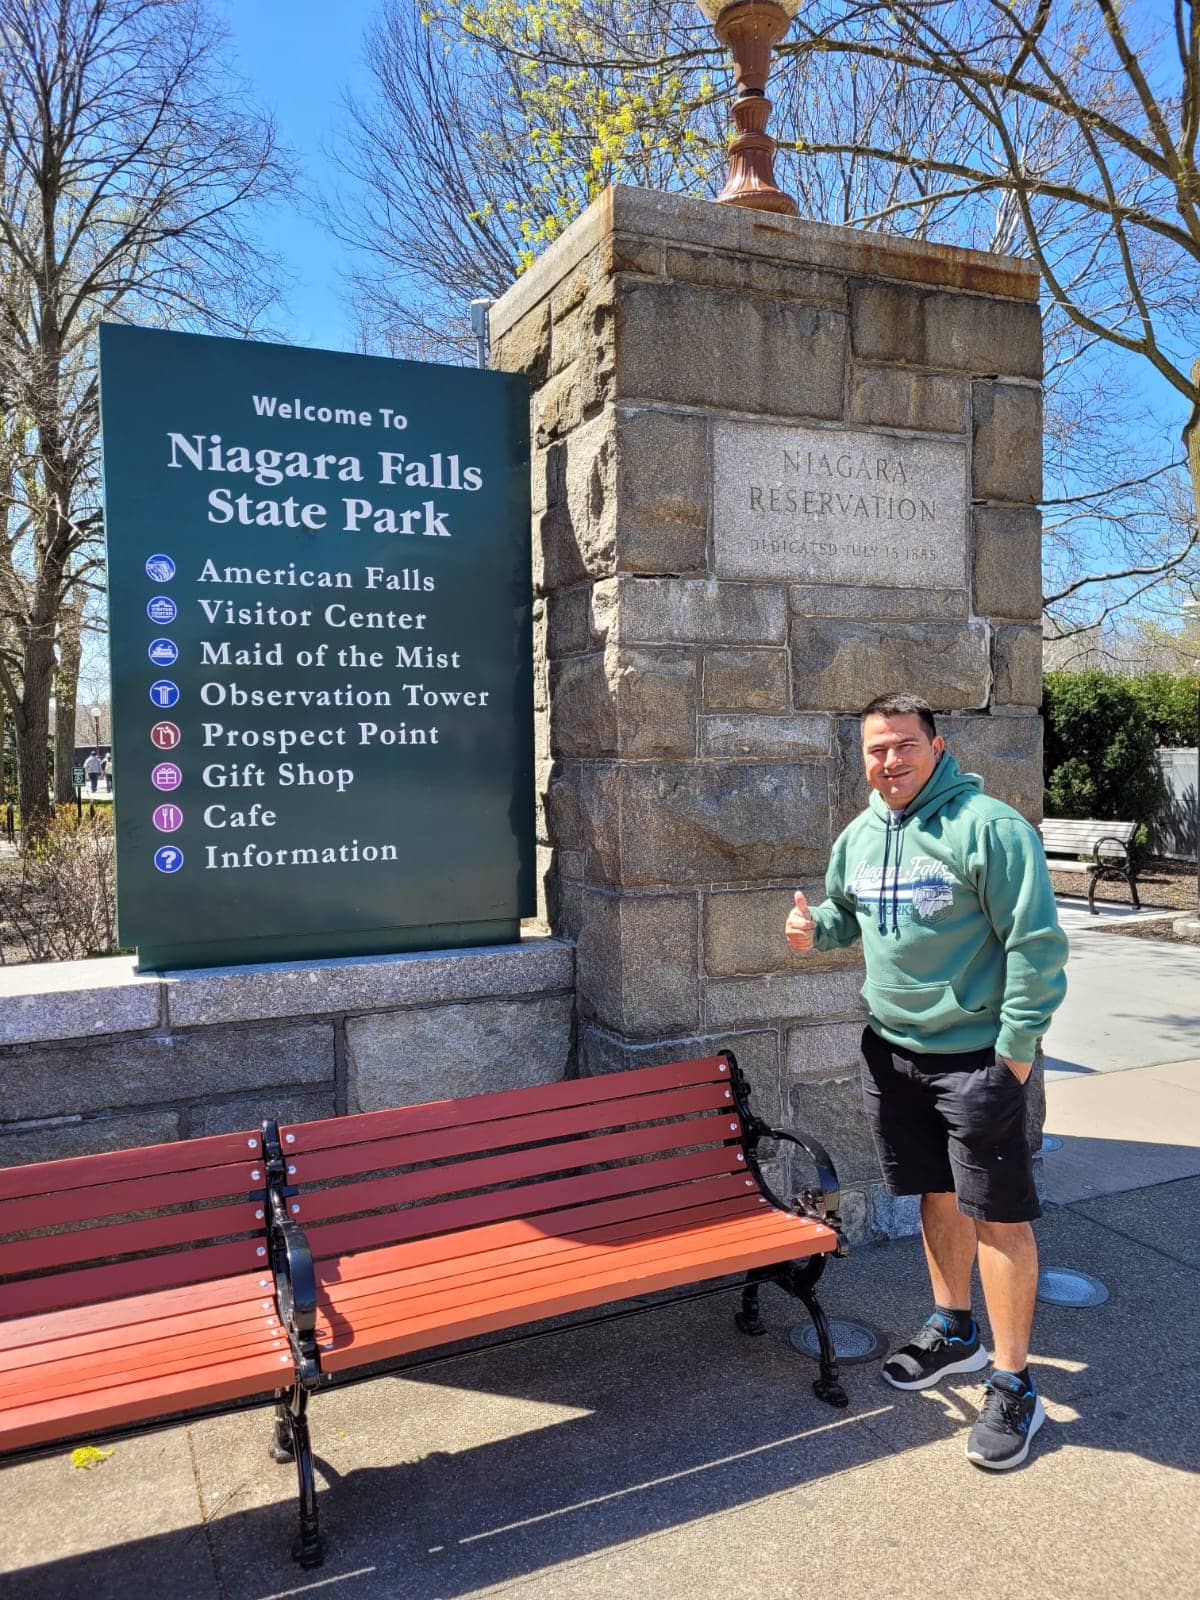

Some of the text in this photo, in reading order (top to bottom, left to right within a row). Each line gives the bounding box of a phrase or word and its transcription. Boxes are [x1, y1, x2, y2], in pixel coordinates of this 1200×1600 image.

[252, 395, 408, 430] Welcome To
[167, 432, 483, 491] Niagara Falls
[783, 449, 907, 484] NIAGARA
[207, 488, 452, 537] State Park
[749, 486, 937, 521] RESERVATION
[749, 539, 838, 557] DEDICATED
[197, 558, 435, 592] American Falls
[197, 599, 427, 630] Visitor Center
[199, 641, 461, 669] Maid of the Mist
[200, 682, 489, 707] Observation Tower
[201, 721, 440, 754] Prospect Point
[202, 762, 354, 793] Gift Shop
[203, 803, 277, 829] Cafe
[204, 839, 399, 870] Information
[905, 856, 951, 881] Falls
